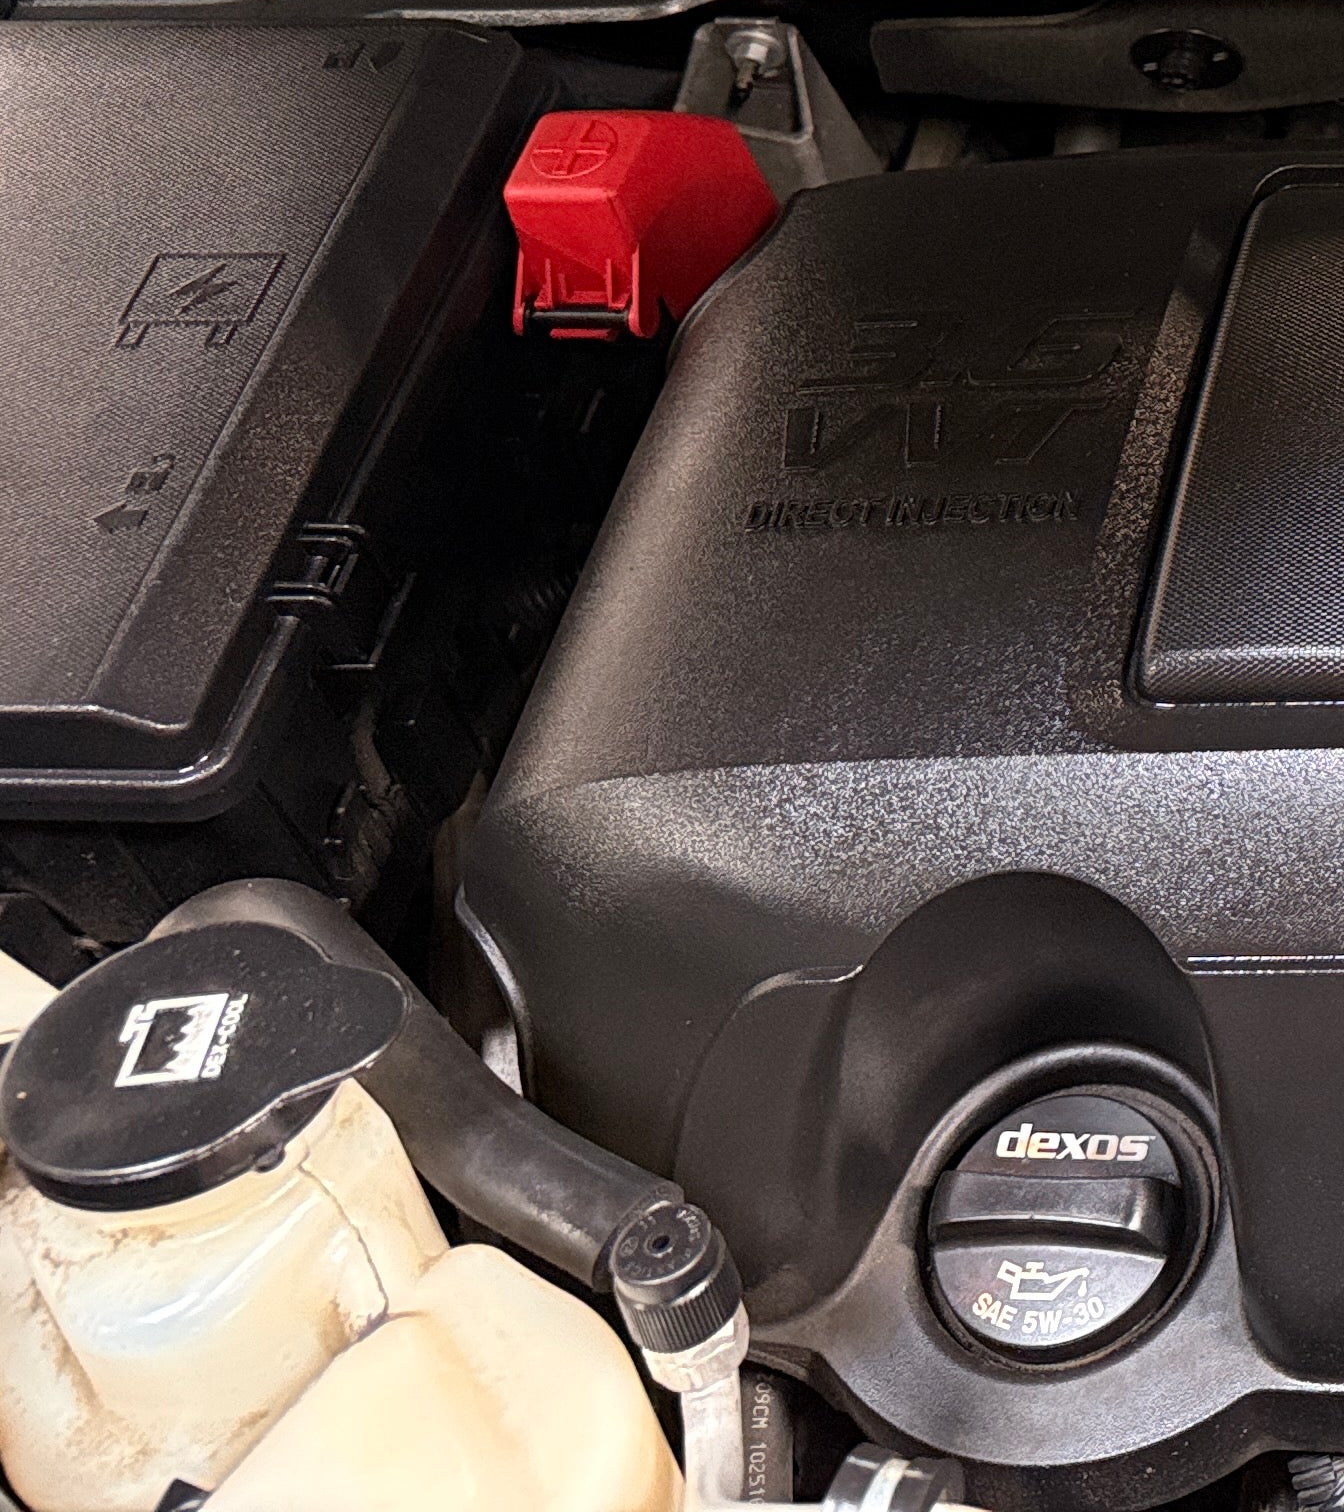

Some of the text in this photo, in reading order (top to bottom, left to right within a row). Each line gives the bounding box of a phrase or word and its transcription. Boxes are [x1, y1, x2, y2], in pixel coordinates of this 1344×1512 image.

[743, 488, 1082, 534] DIRECT INJECTION
[200, 993, 249, 1079] DEX-COOL
[995, 1123, 1150, 1162] dexos
[972, 1292, 1105, 1335] SAE 5W-30
